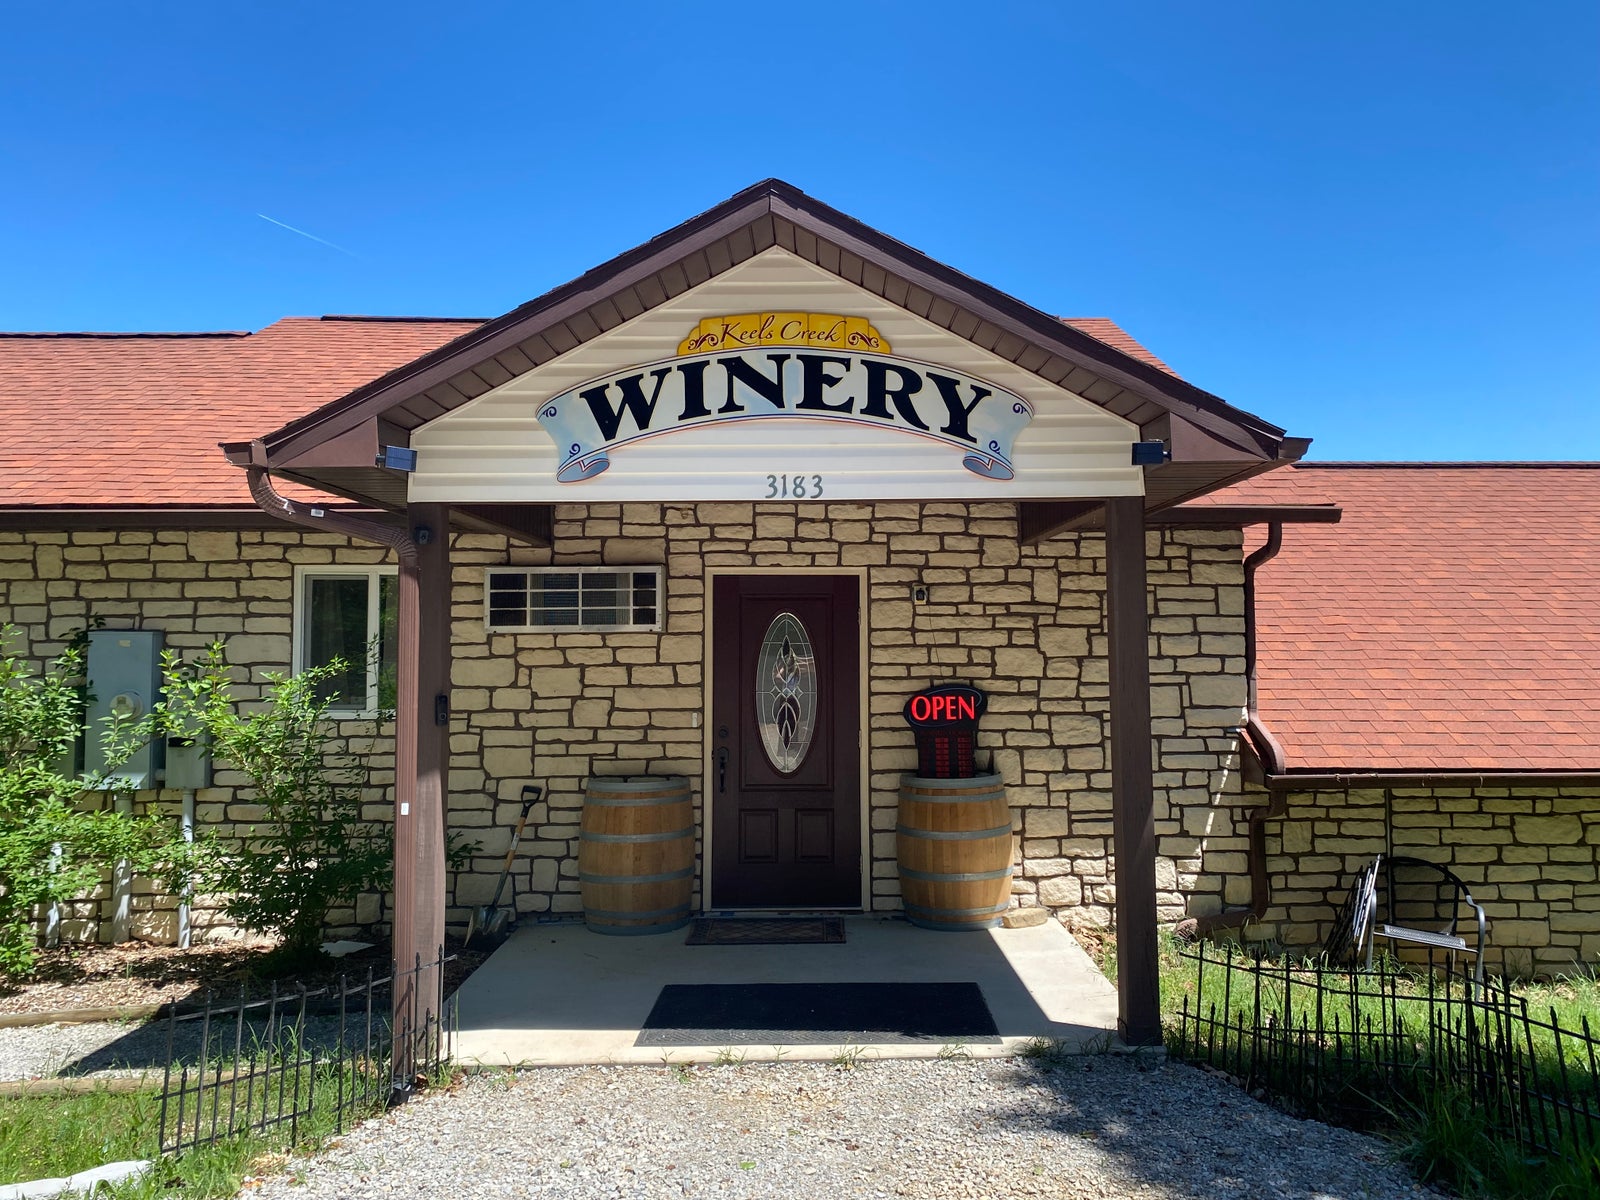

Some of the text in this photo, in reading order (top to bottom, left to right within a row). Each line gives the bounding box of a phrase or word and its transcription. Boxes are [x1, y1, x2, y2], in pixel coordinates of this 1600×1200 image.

[720, 315, 847, 345] Keels Creek
[579, 353, 992, 444] WINERY
[765, 474, 823, 499] 3183
[911, 695, 975, 721] OPEN
